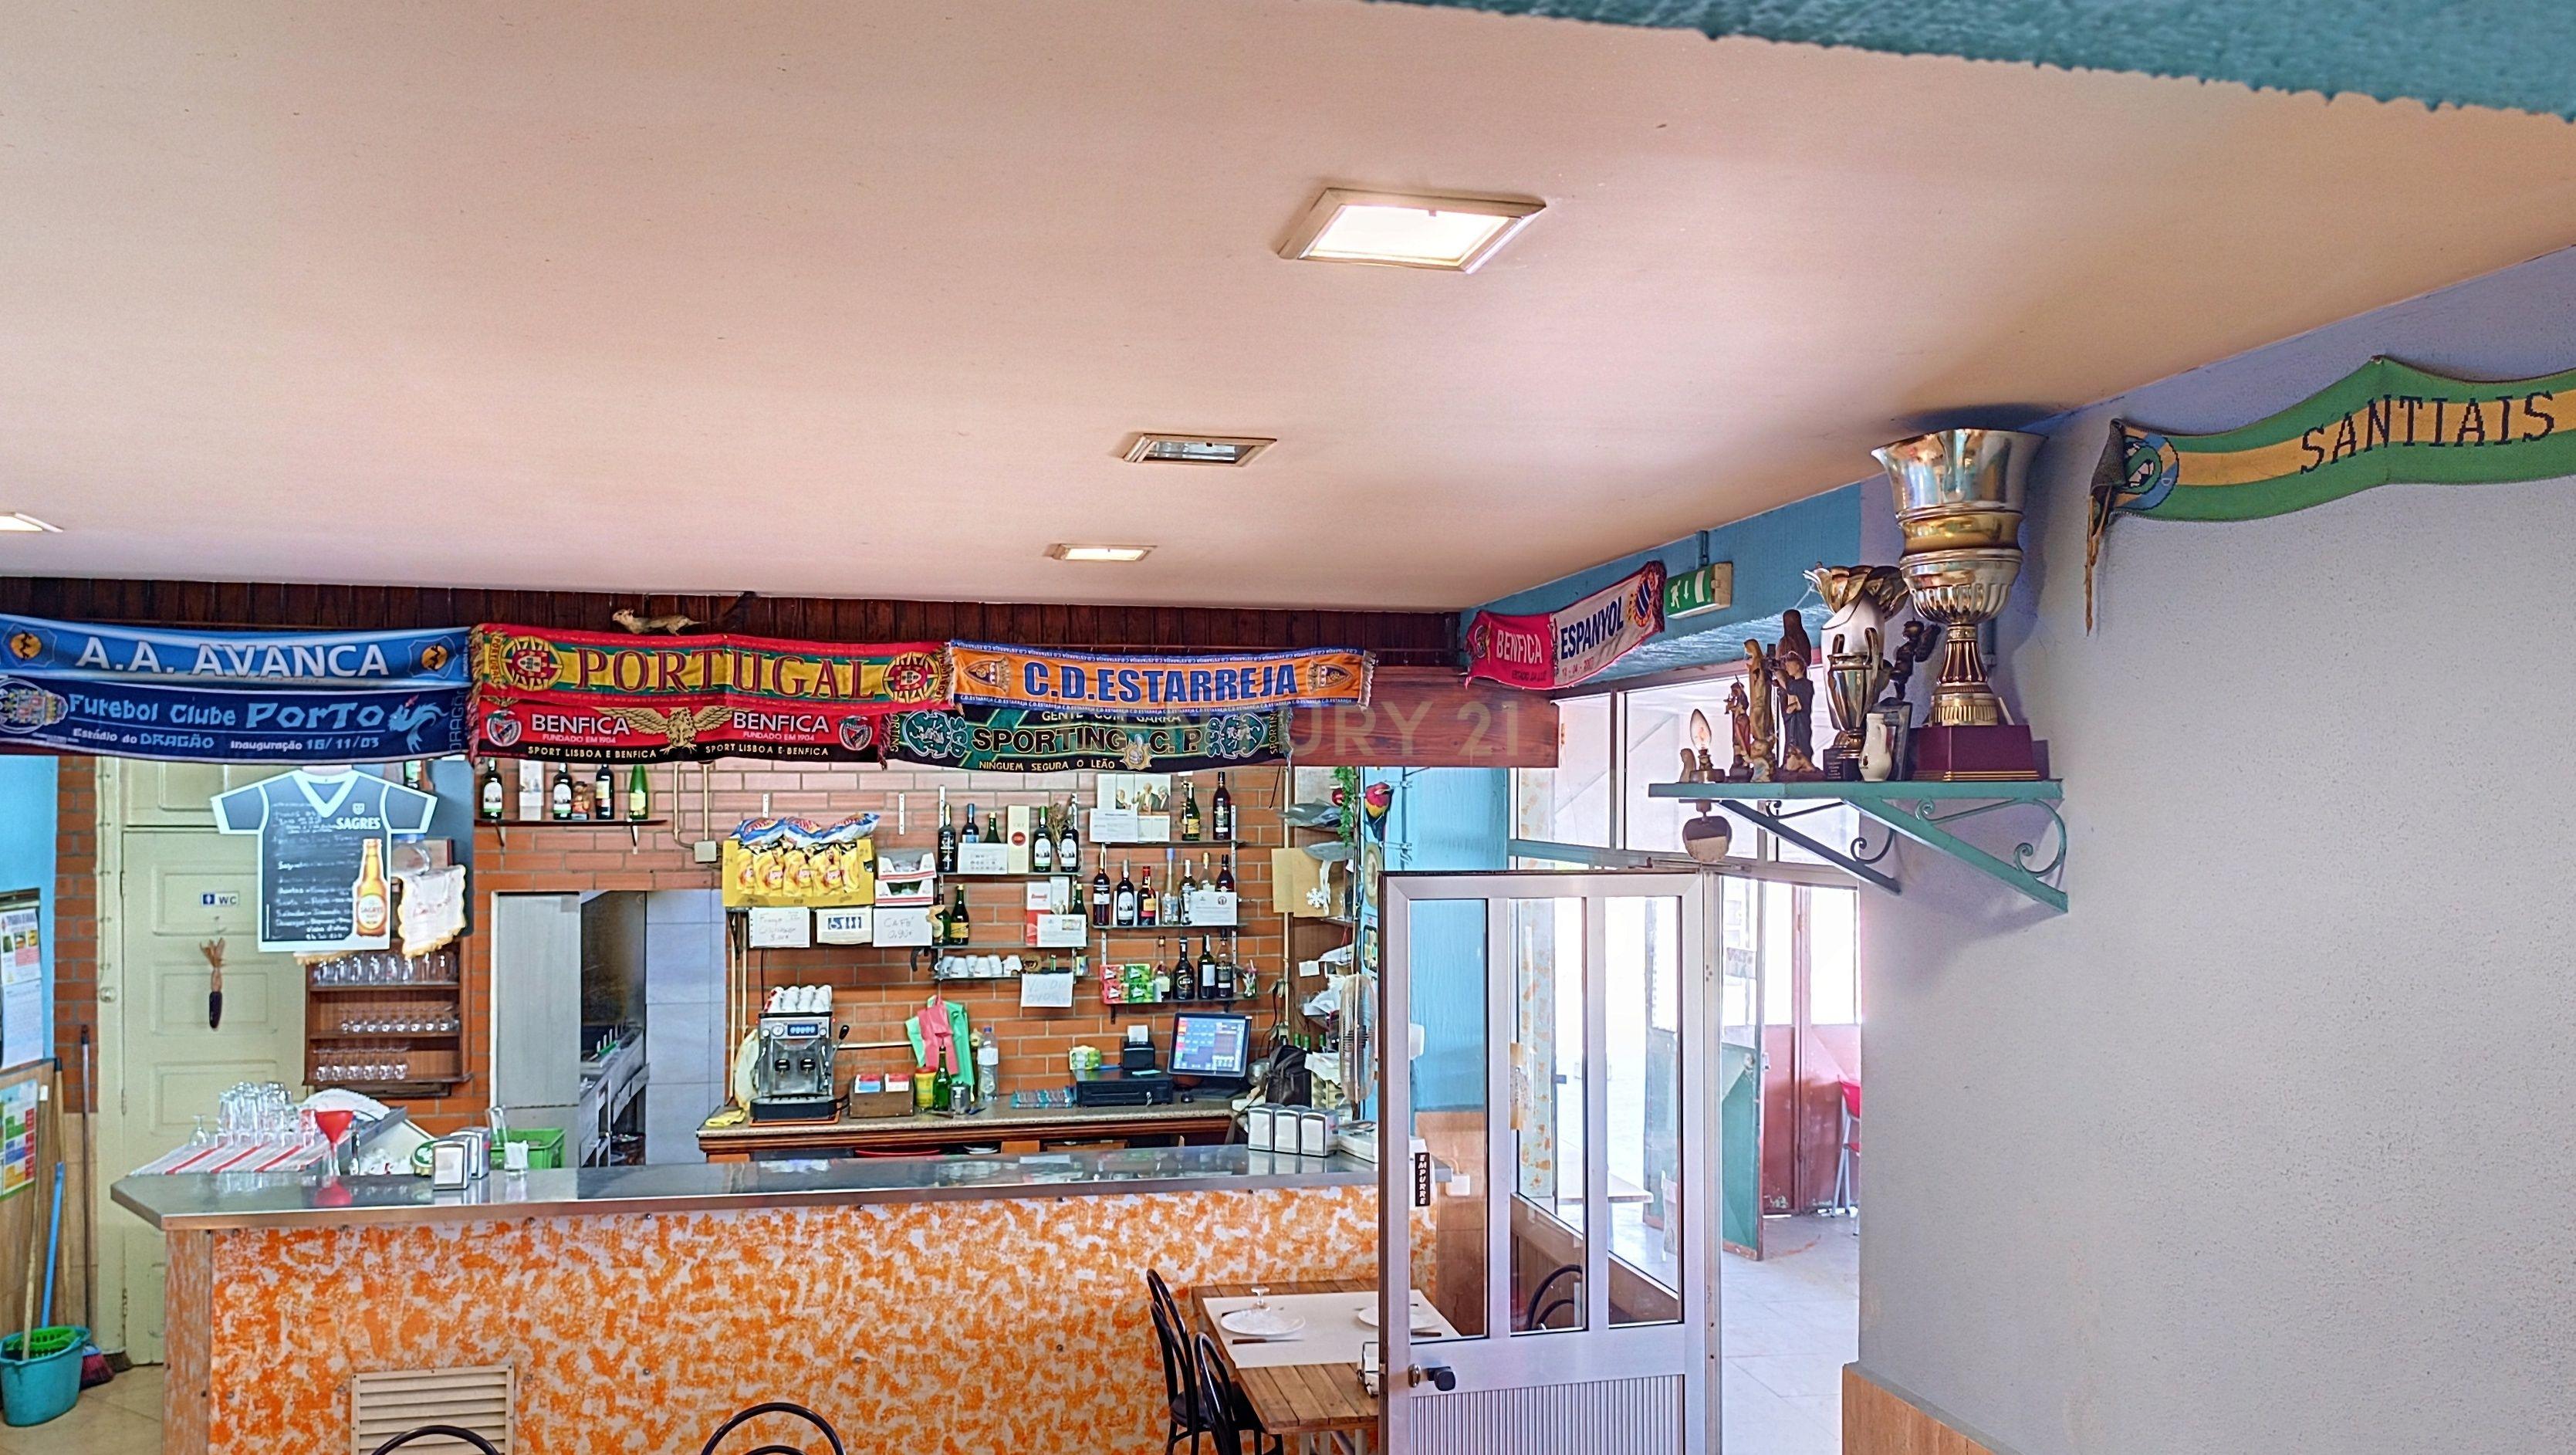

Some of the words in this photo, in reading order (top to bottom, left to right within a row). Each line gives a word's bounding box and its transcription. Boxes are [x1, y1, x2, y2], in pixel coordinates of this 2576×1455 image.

[2300, 391, 2554, 475] SANTIAIS
[1560, 596, 1624, 660] ESPANYOL
[76, 636, 176, 675] A.A.
[189, 642, 390, 678] AVANCA
[1496, 629, 1543, 664] BENFICA
[574, 647, 876, 700] PORTUGAL
[69, 694, 158, 722] Futebol
[170, 704, 236, 726] Clube
[732, 712, 830, 733] BENFICA
[531, 713, 630, 736] BENFICA
[743, 732, 782, 741] FUNDADO
[798, 733, 815, 742] 1904
[890, 713, 901, 753] ORTING
[73, 728, 117, 741] Estádio
[122, 734, 137, 744] do
[140, 733, 215, 749] DRAGÃO
[230, 739, 303, 752] Inauguração
[543, 733, 583, 743] FUNDADO
[599, 736, 617, 744] 1904
[705, 743, 735, 753] SPORT
[739, 743, 773, 754] LISBOA
[787, 746, 829, 756] BENFICA
[971, 726, 1128, 754] SPORTING
[528, 746, 561, 756] SPORT
[565, 748, 602, 758] LISBOA
[606, 749, 611, 758] E
[615, 749, 657, 759] BENFICA
[979, 761, 1024, 771] NINGUEM
[1032, 760, 1070, 771] SEGURA
[1077, 759, 1084, 767] O
[1090, 758, 1116, 770] LEÃO
[336, 817, 382, 830] SAGRES
[1418, 1154, 1428, 1205] EMPURRE
